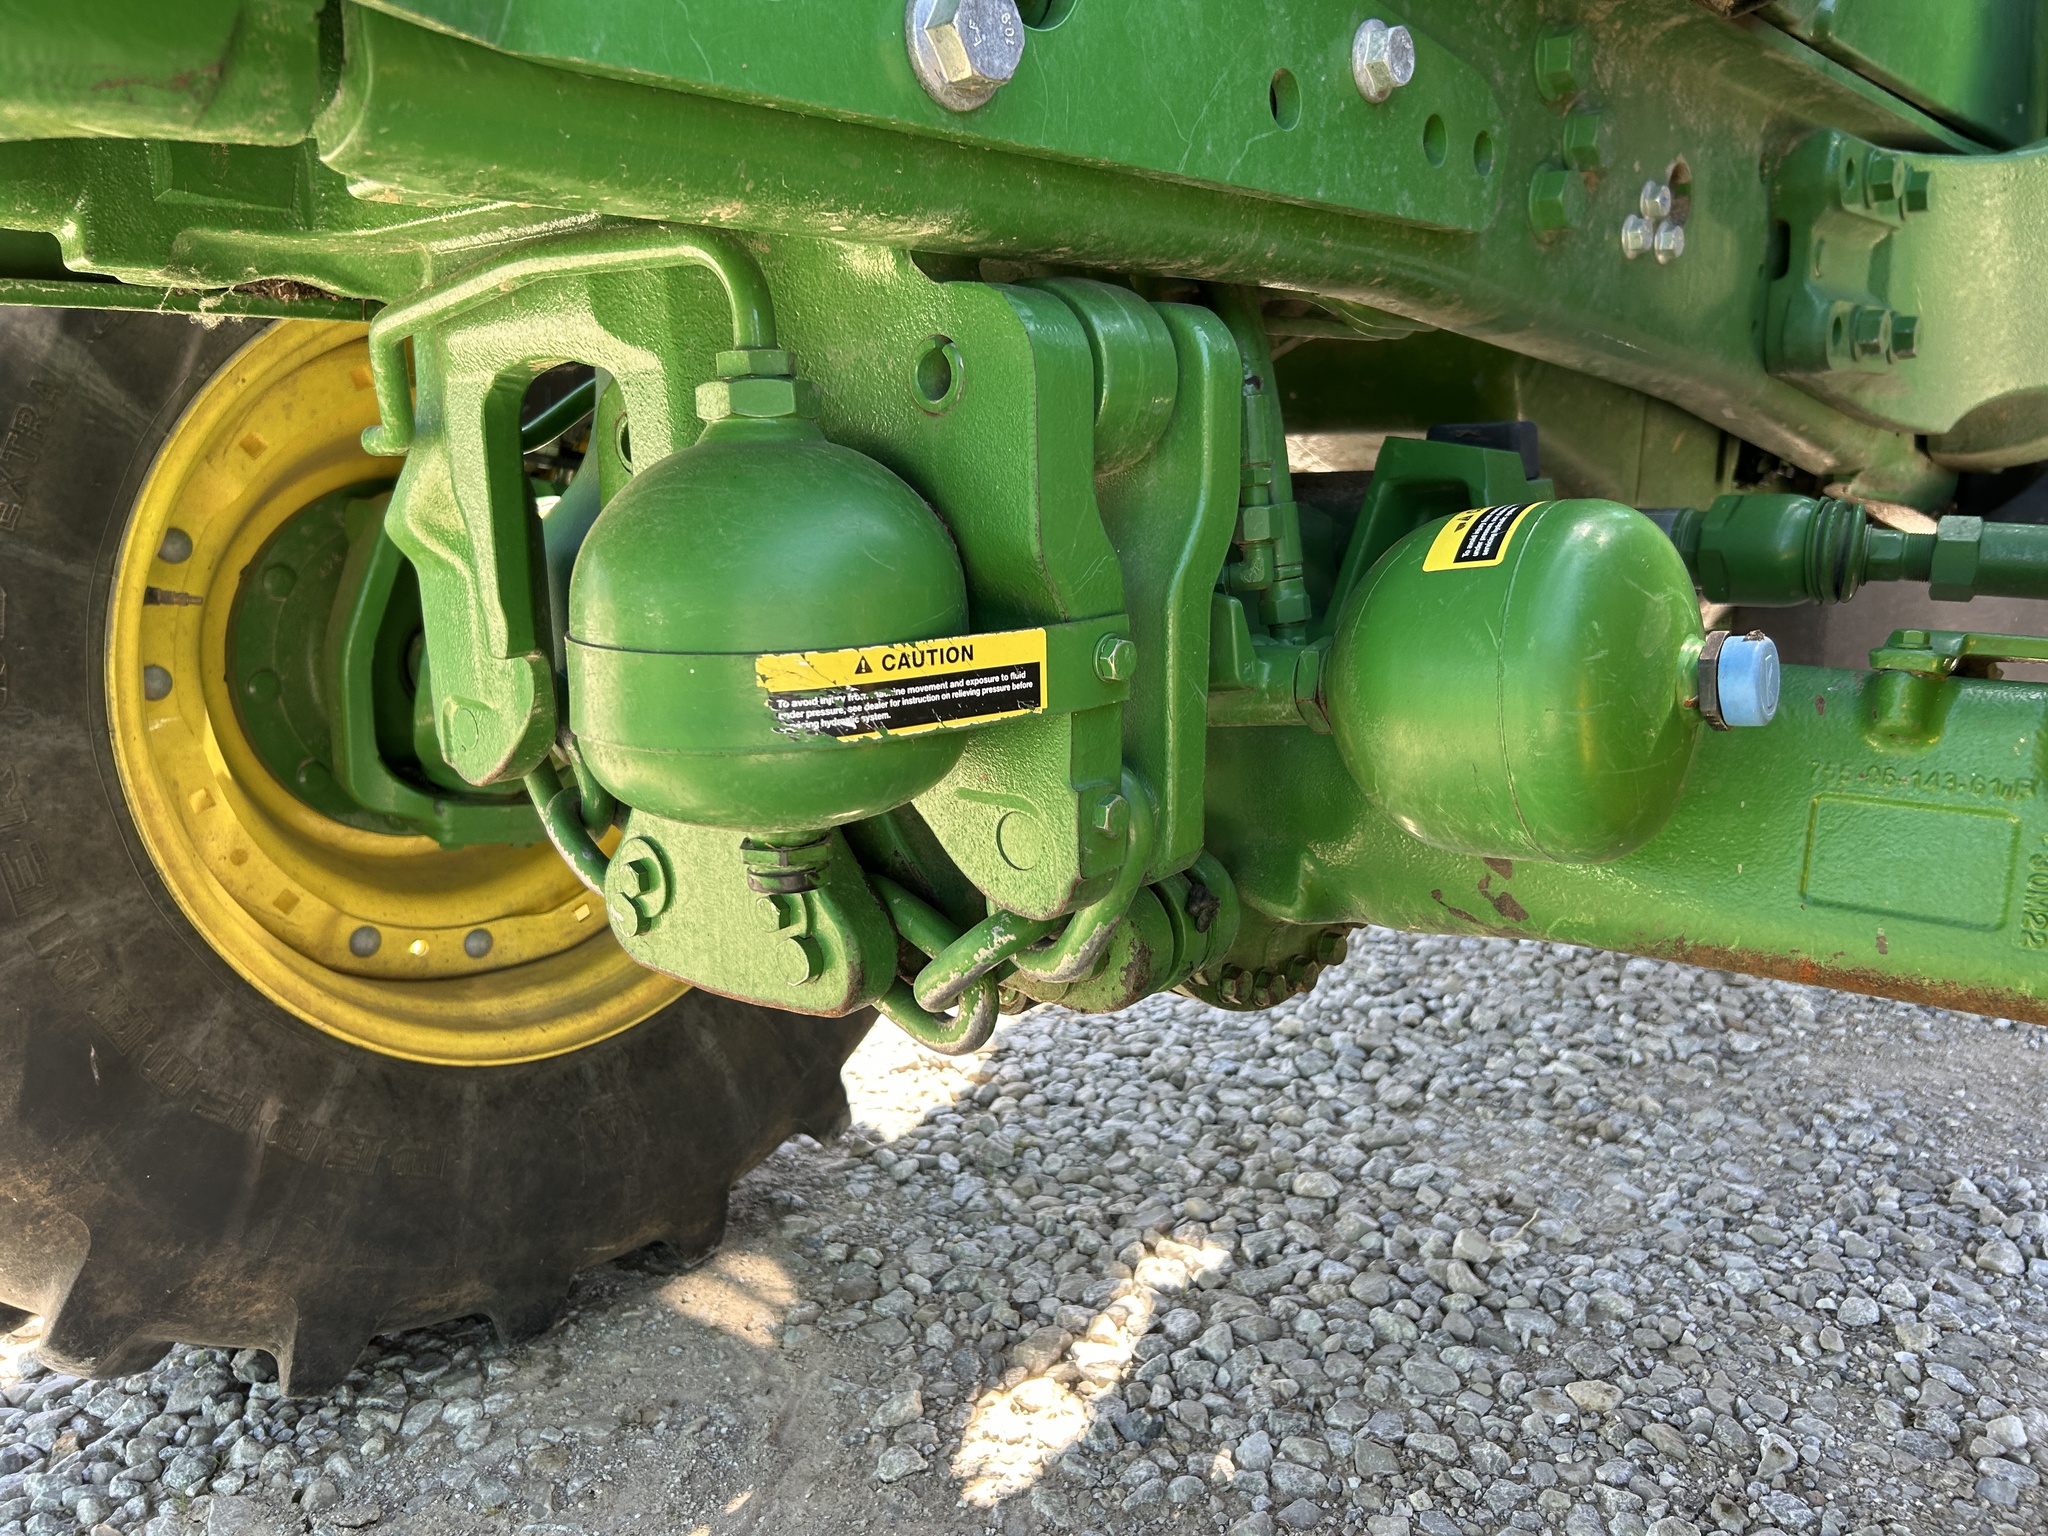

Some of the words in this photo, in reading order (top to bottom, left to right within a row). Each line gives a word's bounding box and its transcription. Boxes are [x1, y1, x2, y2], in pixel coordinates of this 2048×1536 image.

[0, 376, 63, 532] EXTRA
[882, 644, 973, 671] CAUTION
[776, 699, 790, 708] To
[791, 697, 818, 708] avoid
[907, 681, 948, 694] movement
[950, 679, 964, 689] and
[965, 675, 1000, 688] exposure
[1001, 673, 1009, 682] to
[1010, 670, 1026, 680] fluid
[806, 707, 846, 719] pressure,
[864, 700, 888, 711] dealer
[890, 698, 901, 708] for
[902, 692, 940, 706] instruction
[942, 691, 952, 699] on
[952, 687, 980, 699] relieving
[982, 684, 1010, 697] pressure
[1012, 681, 1033, 691] before
